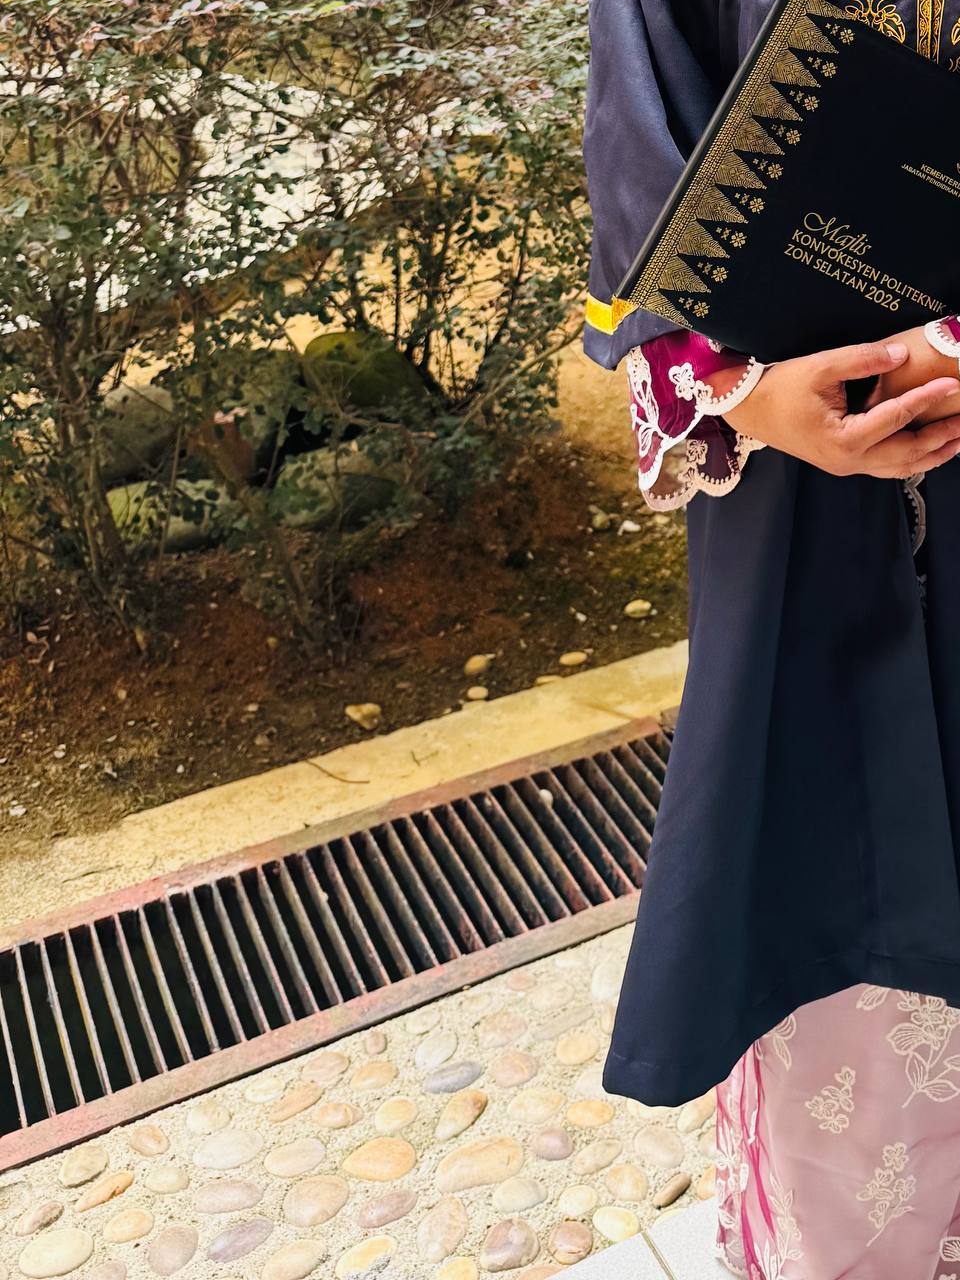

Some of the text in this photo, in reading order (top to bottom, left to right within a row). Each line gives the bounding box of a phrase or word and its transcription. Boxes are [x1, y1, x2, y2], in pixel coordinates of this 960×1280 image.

[900, 163, 927, 180] JABATAN
[925, 176, 959, 198] PENDIDIKAN
[804, 212, 872, 256] Majlis
[784, 243, 901, 312] ZON SELATAN 2026
[791, 229, 947, 315] KONVOKESYEN POLITEKNIK
